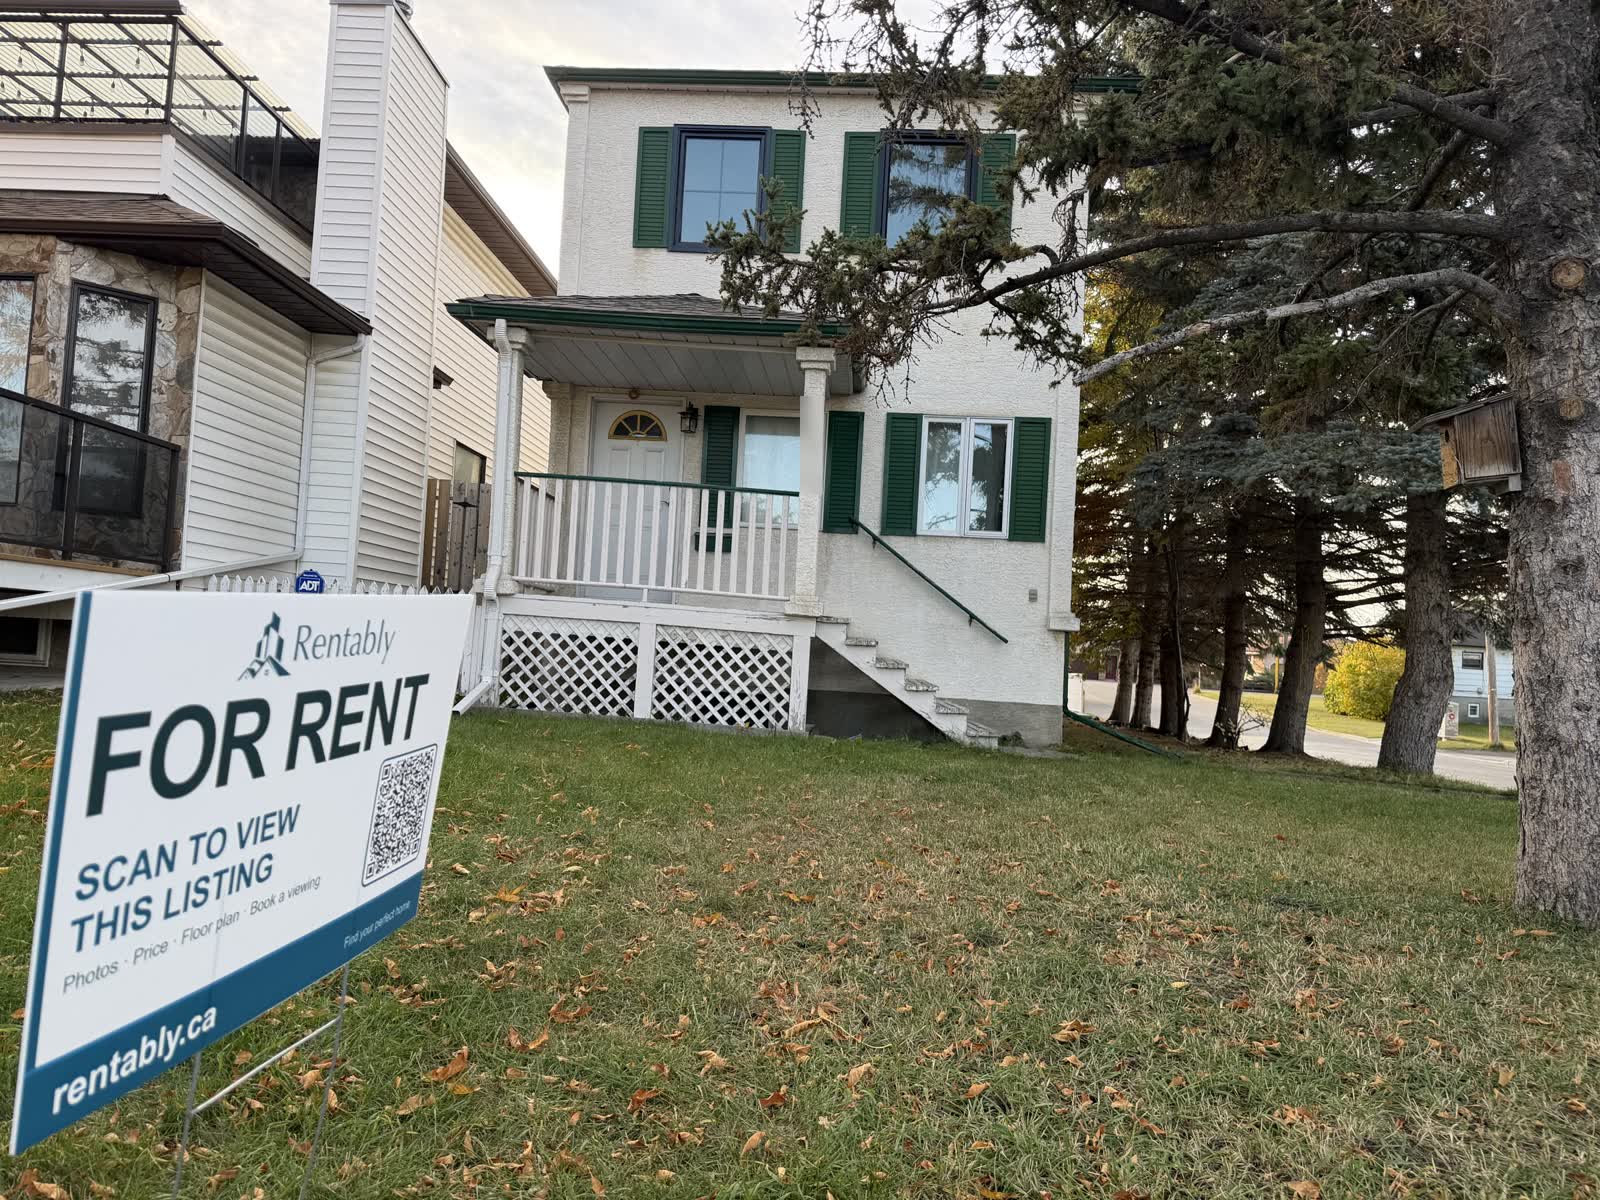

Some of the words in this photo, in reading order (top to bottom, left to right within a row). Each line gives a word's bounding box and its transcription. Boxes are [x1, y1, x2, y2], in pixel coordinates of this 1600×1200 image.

[300, 580, 320, 591] ADT
[293, 619, 395, 664] Rentably
[86, 697, 271, 817] FOR
[285, 673, 430, 771] RENT
[75, 840, 177, 901] SCAN
[189, 827, 227, 865] TO
[237, 804, 301, 849] VIEW
[62, 960, 119, 994] Photos
[133, 940, 169, 965] Price
[181, 920, 214, 945] Floor
[215, 911, 240, 934] plan
[250, 895, 276, 916] Book
[278, 892, 285, 903] a
[287, 875, 321, 897] viewing
[71, 896, 153, 953] THIS
[163, 853, 273, 920] LISTING
[52, 1006, 217, 1114] rentably.ca
